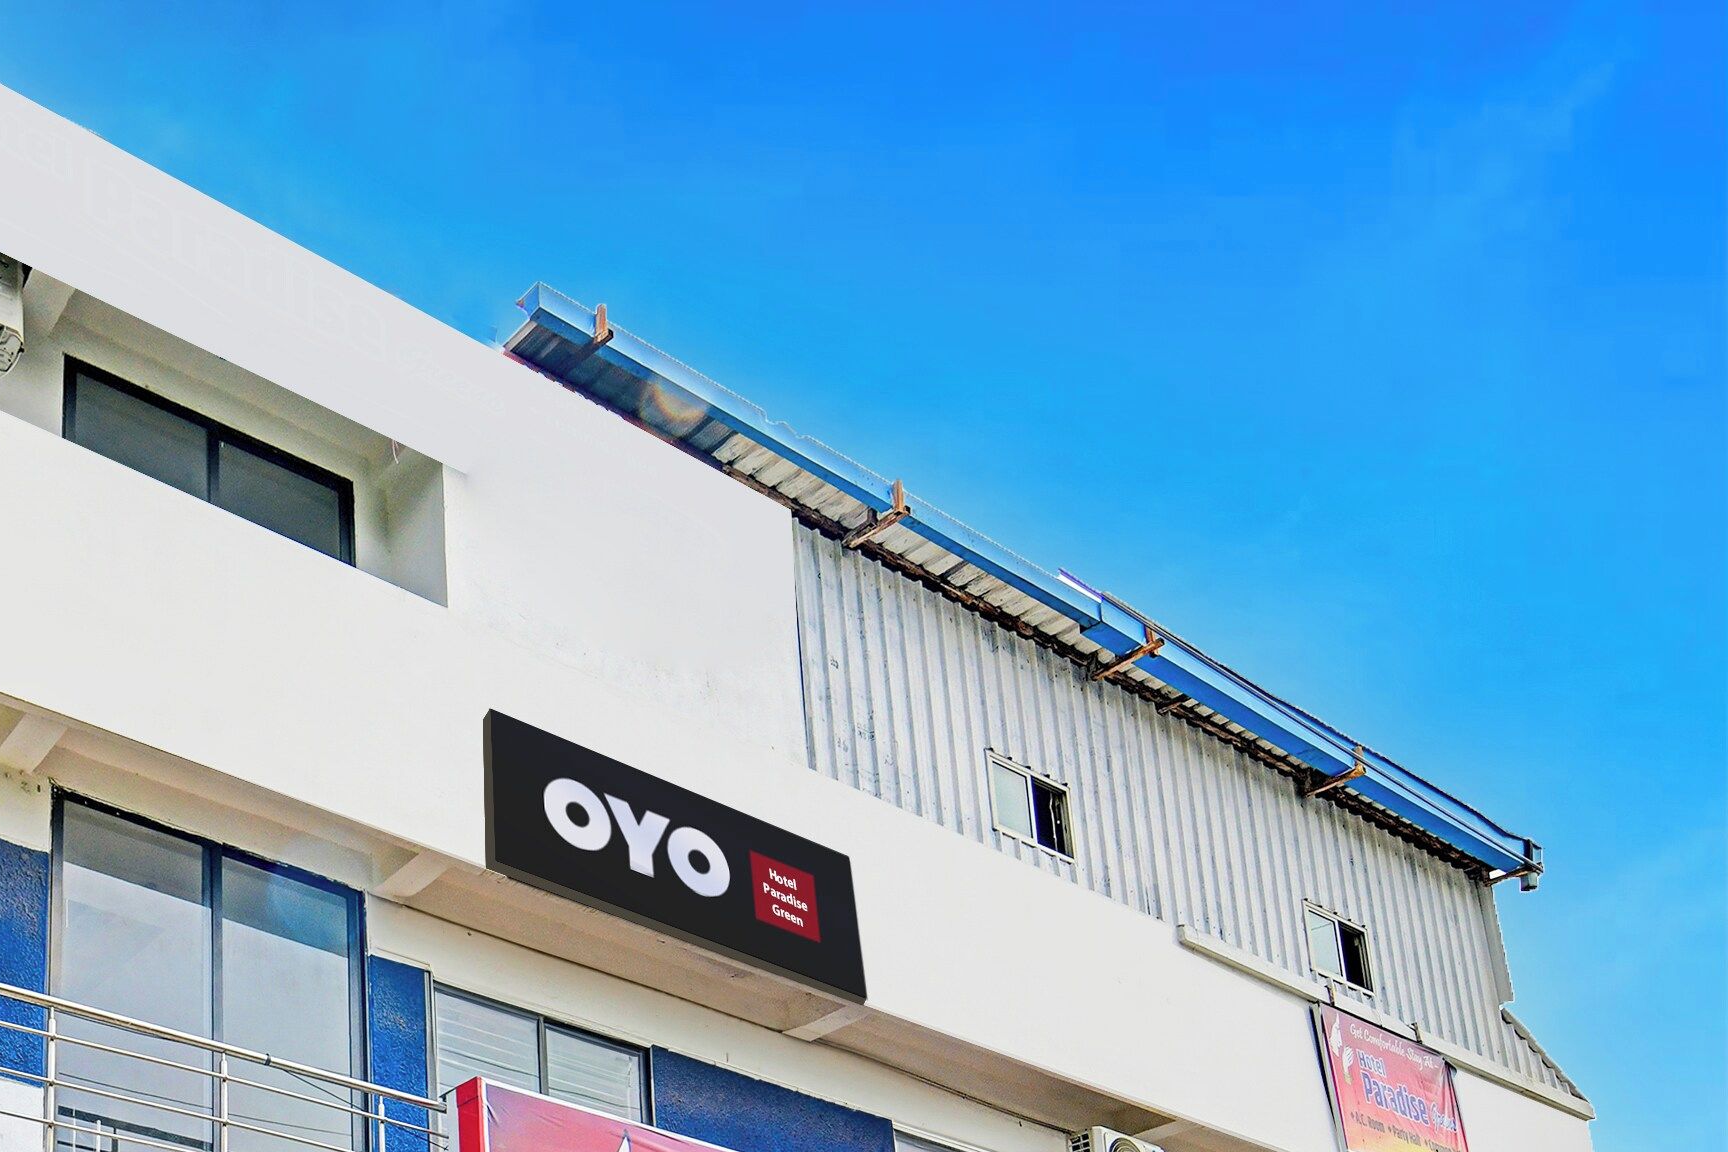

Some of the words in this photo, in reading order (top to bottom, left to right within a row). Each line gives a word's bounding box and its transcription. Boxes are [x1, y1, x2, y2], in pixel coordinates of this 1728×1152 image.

[543, 777, 731, 897] OYO
[768, 867, 798, 891] Hotel
[762, 882, 809, 912] Paradise
[772, 903, 804, 928] Green
[1349, 1023, 1364, 1040] Get
[1356, 1049, 1387, 1078] Hotel
[1361, 1070, 1431, 1126] Paradise
